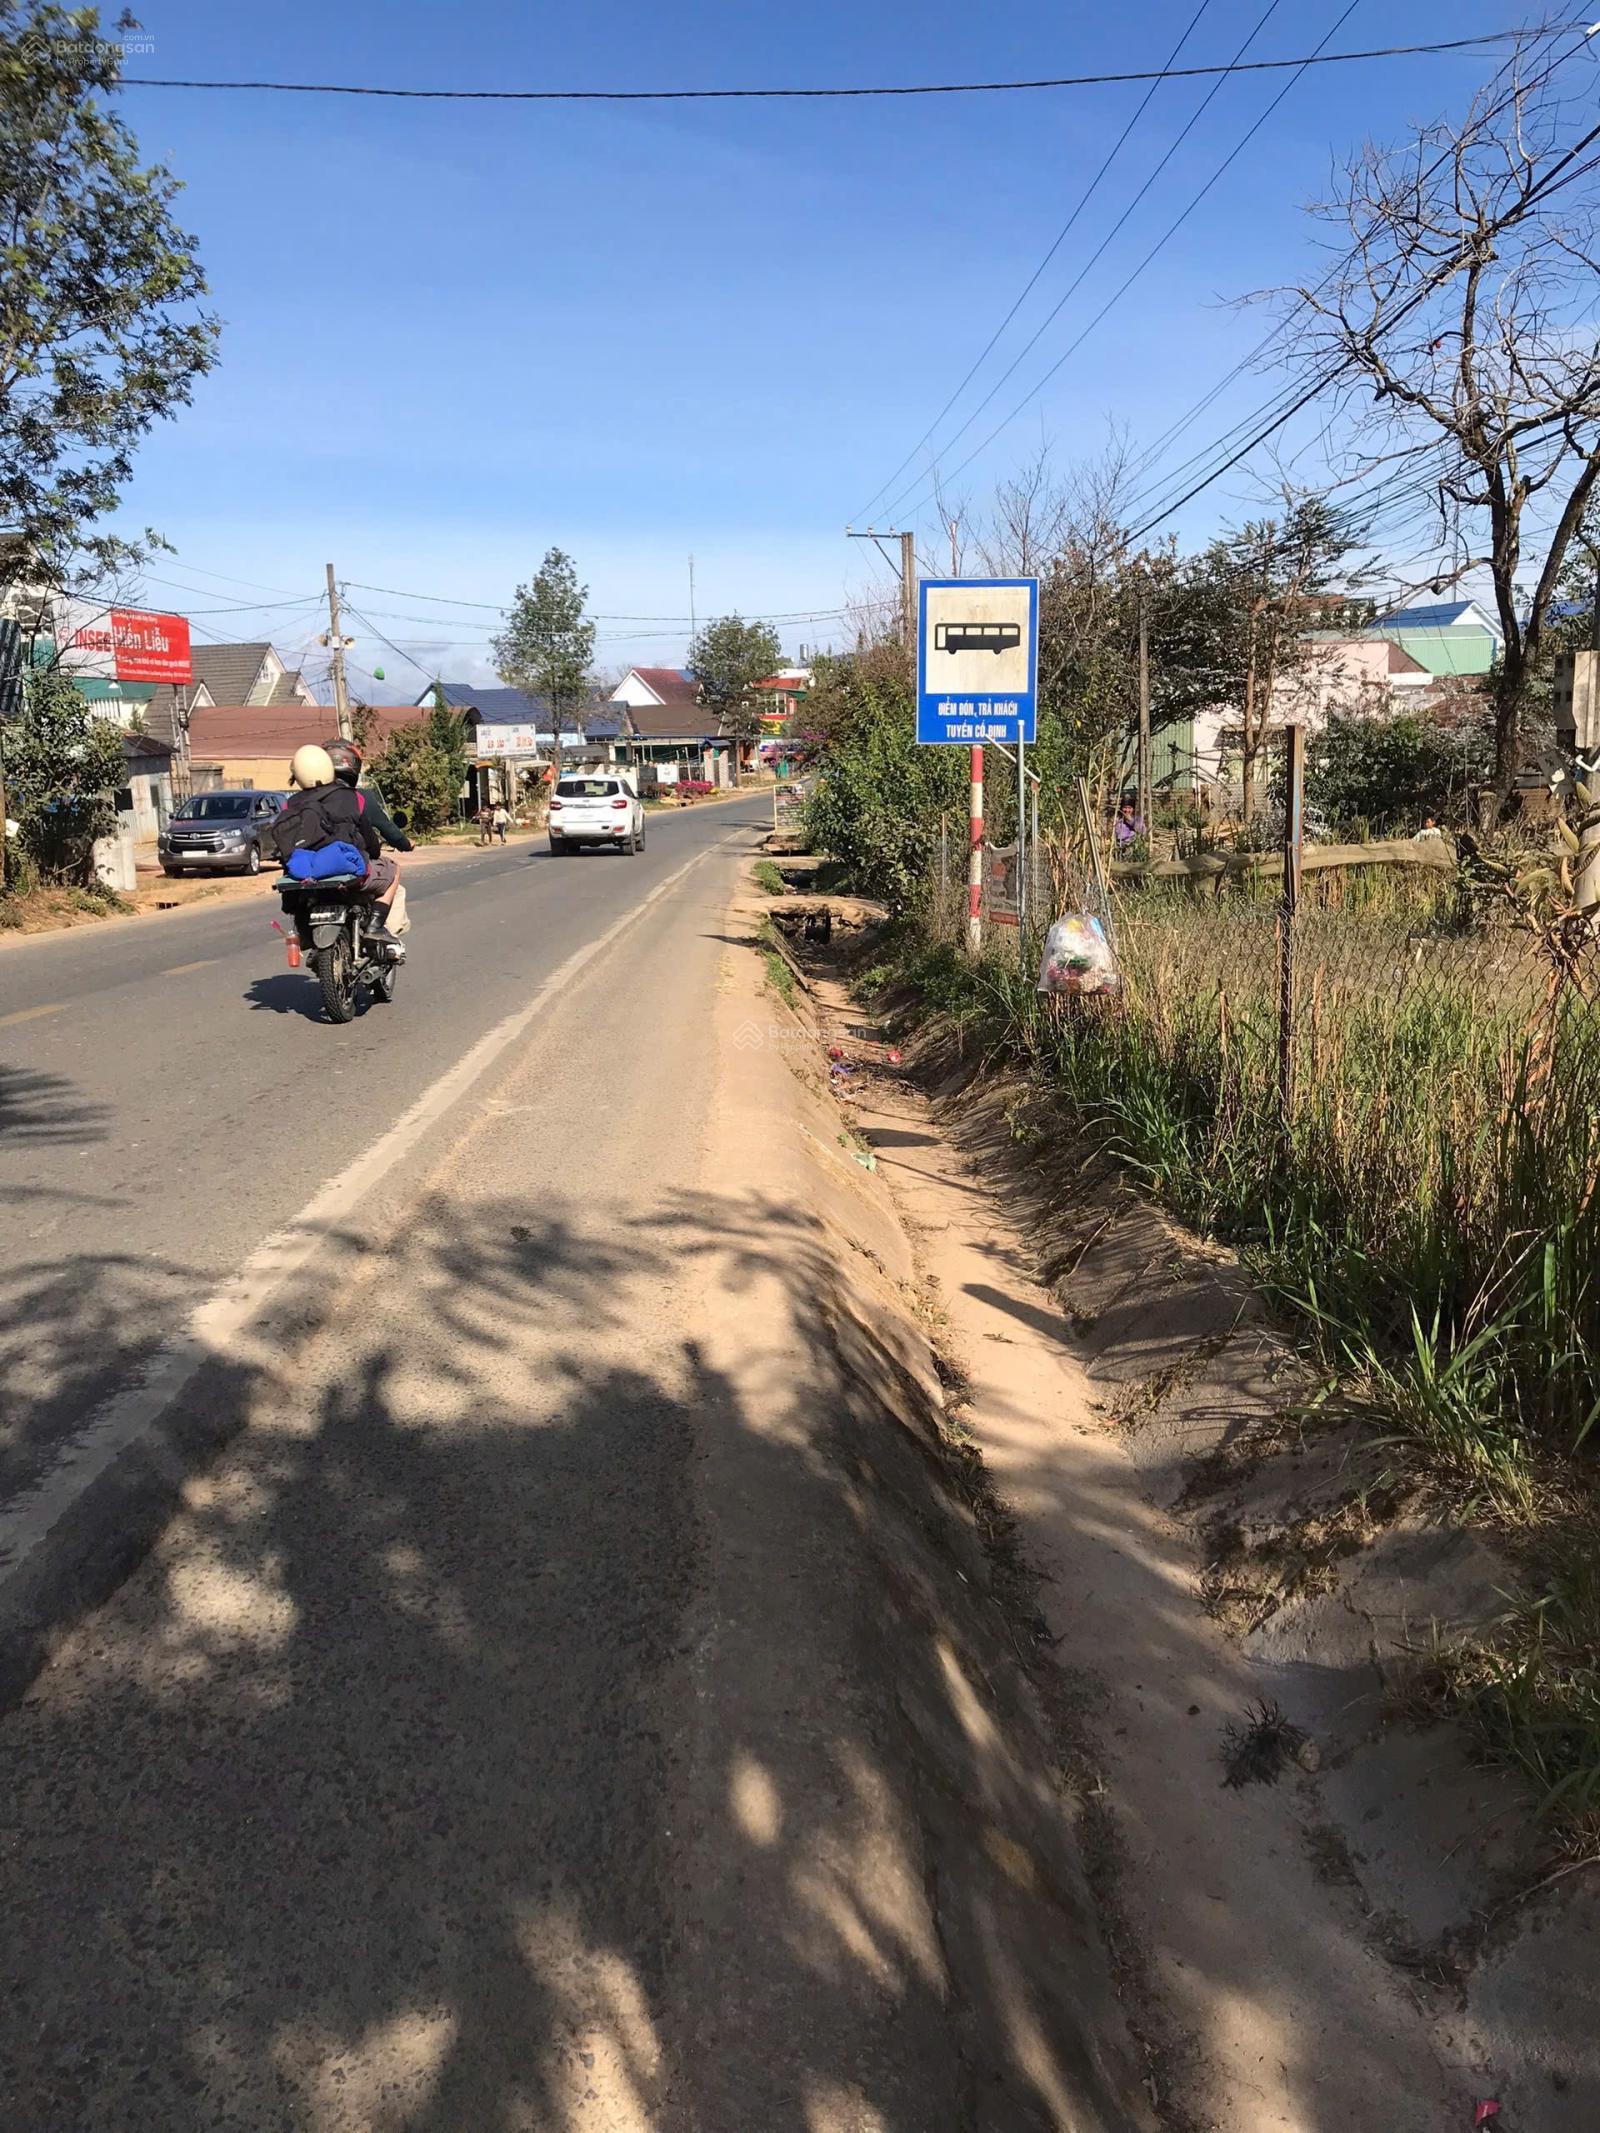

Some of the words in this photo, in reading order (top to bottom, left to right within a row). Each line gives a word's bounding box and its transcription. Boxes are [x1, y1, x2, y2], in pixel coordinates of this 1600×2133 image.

[75, 628, 112, 652] INSEE
[978, 698, 992, 716] TRẢ
[993, 700, 1018, 716] KHÁCH
[946, 720, 973, 738] TUYẾN
